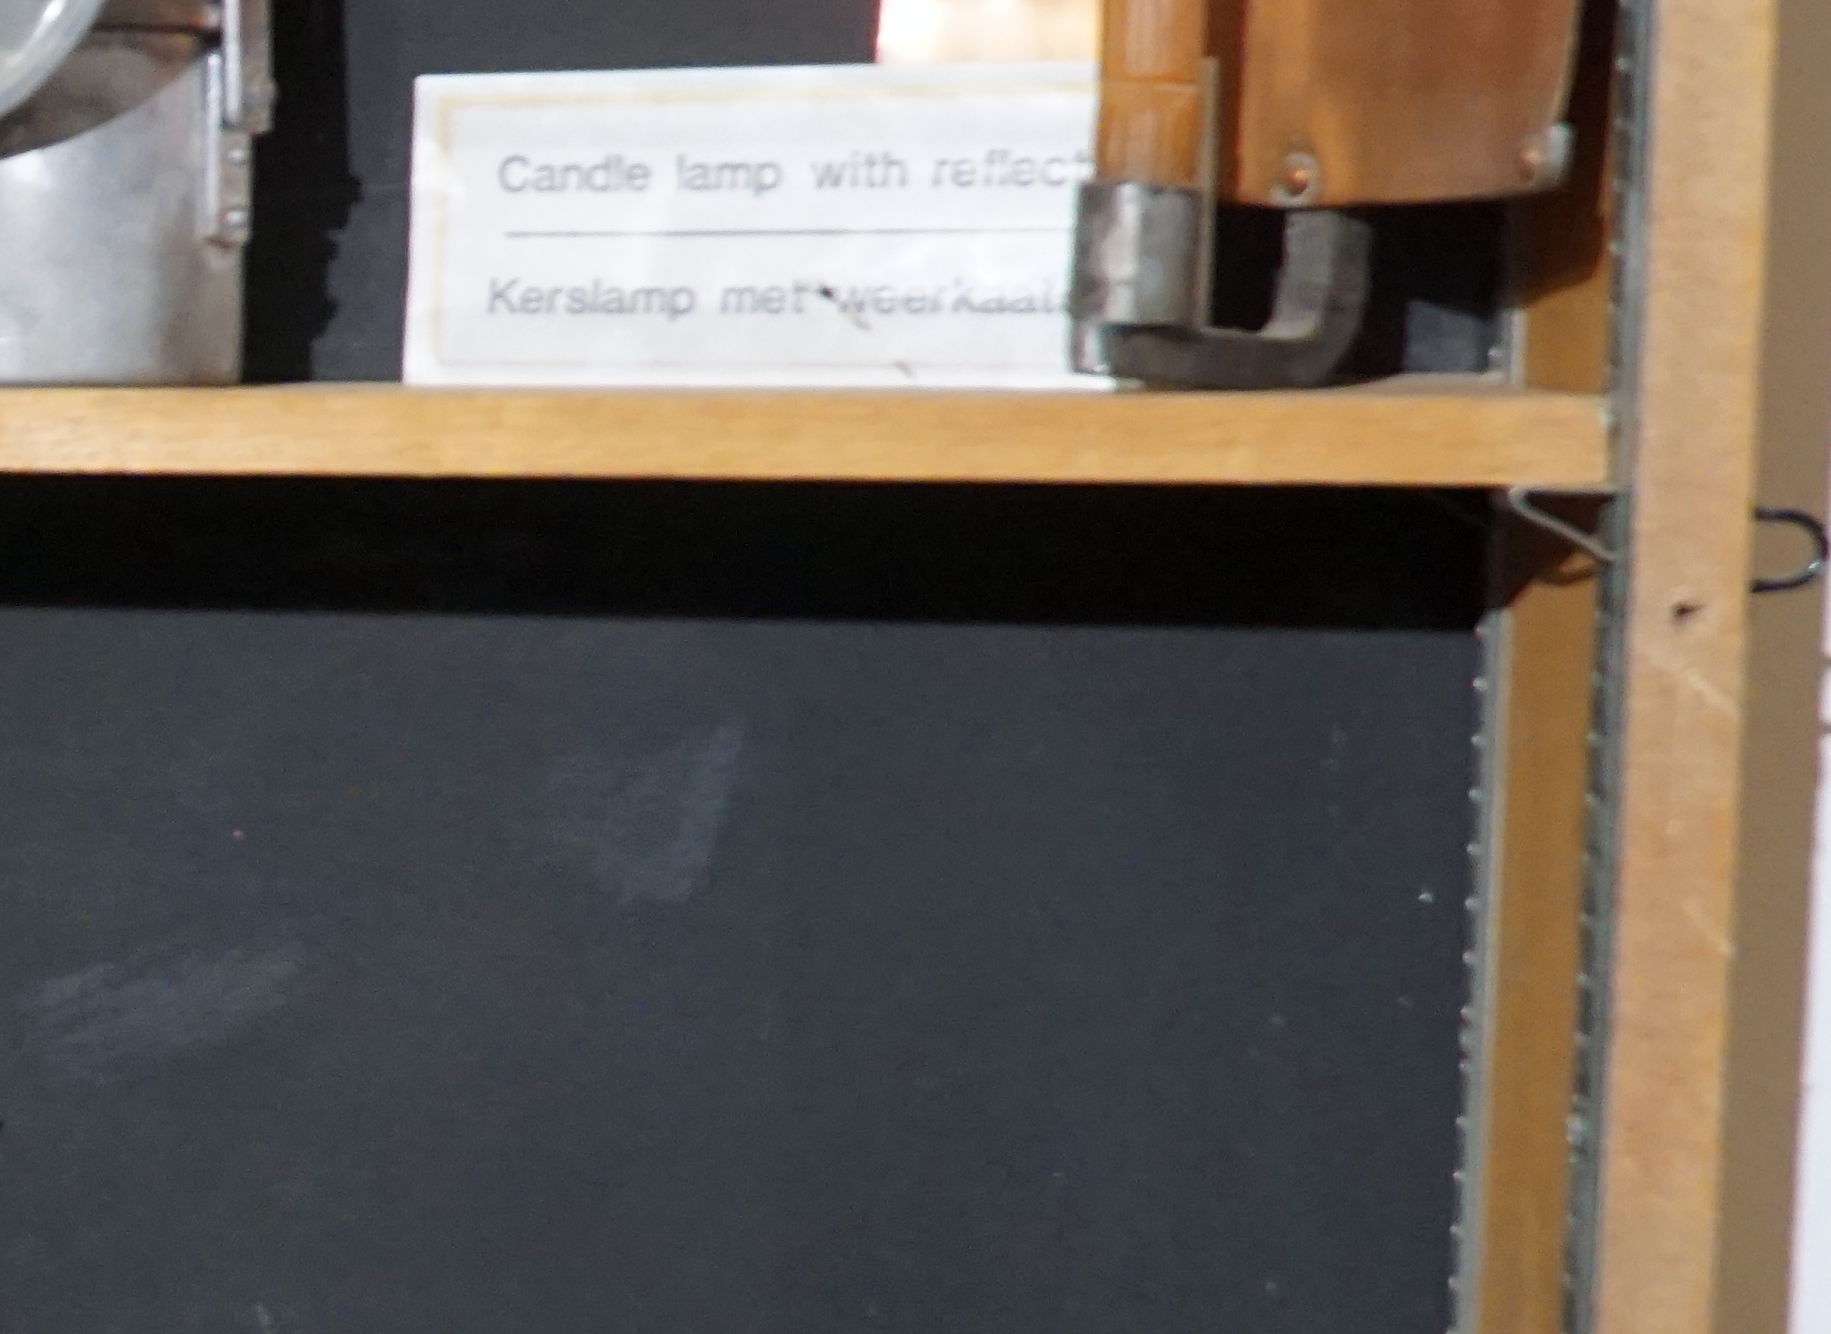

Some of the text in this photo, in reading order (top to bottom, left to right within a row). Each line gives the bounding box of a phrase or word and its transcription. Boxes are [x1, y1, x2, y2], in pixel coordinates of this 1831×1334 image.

[498, 153, 652, 195] Candle
[676, 153, 784, 197] lamp
[810, 149, 909, 189] with
[487, 277, 696, 321] Kerslamp
[720, 278, 810, 316] met
